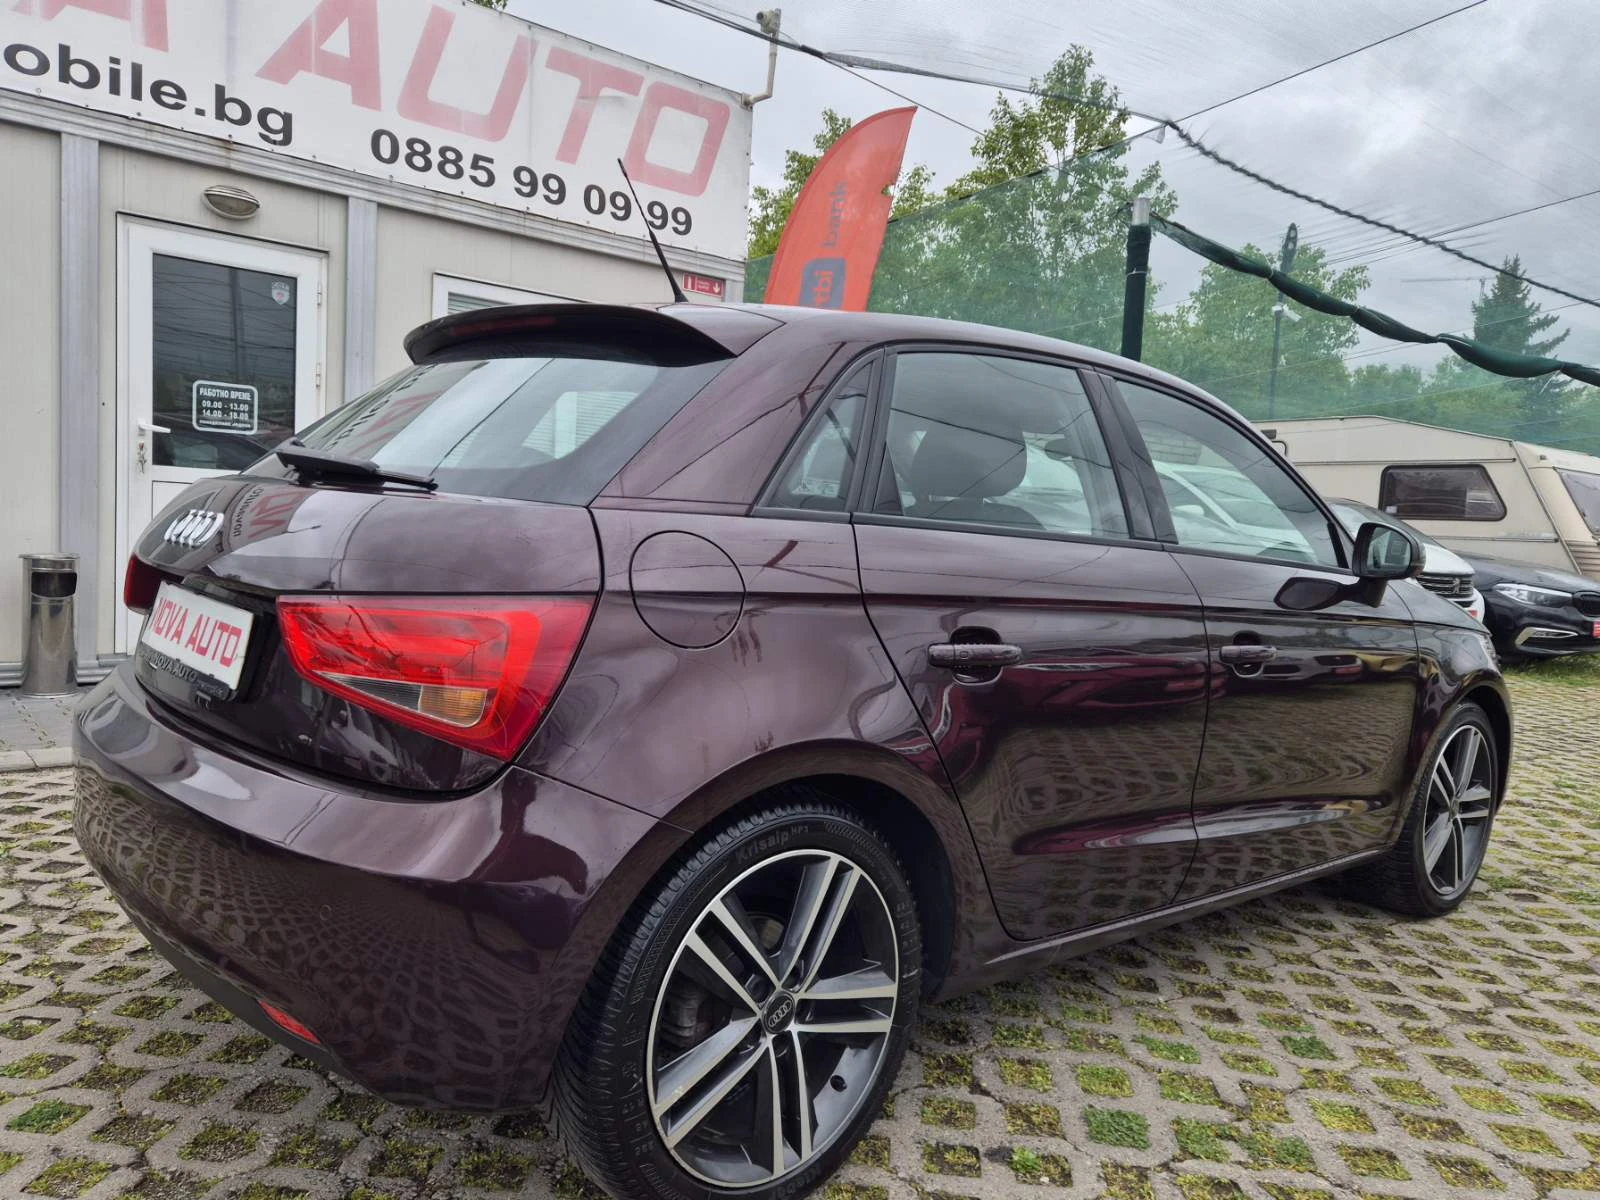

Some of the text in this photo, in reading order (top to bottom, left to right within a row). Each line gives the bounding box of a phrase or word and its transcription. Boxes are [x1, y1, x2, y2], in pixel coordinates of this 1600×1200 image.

[4, 43, 294, 147] obile.bg
[255, 0, 731, 197] AUTO
[371, 128, 693, 236] 0885 99 09 99
[184, 613, 243, 668] AUTO
